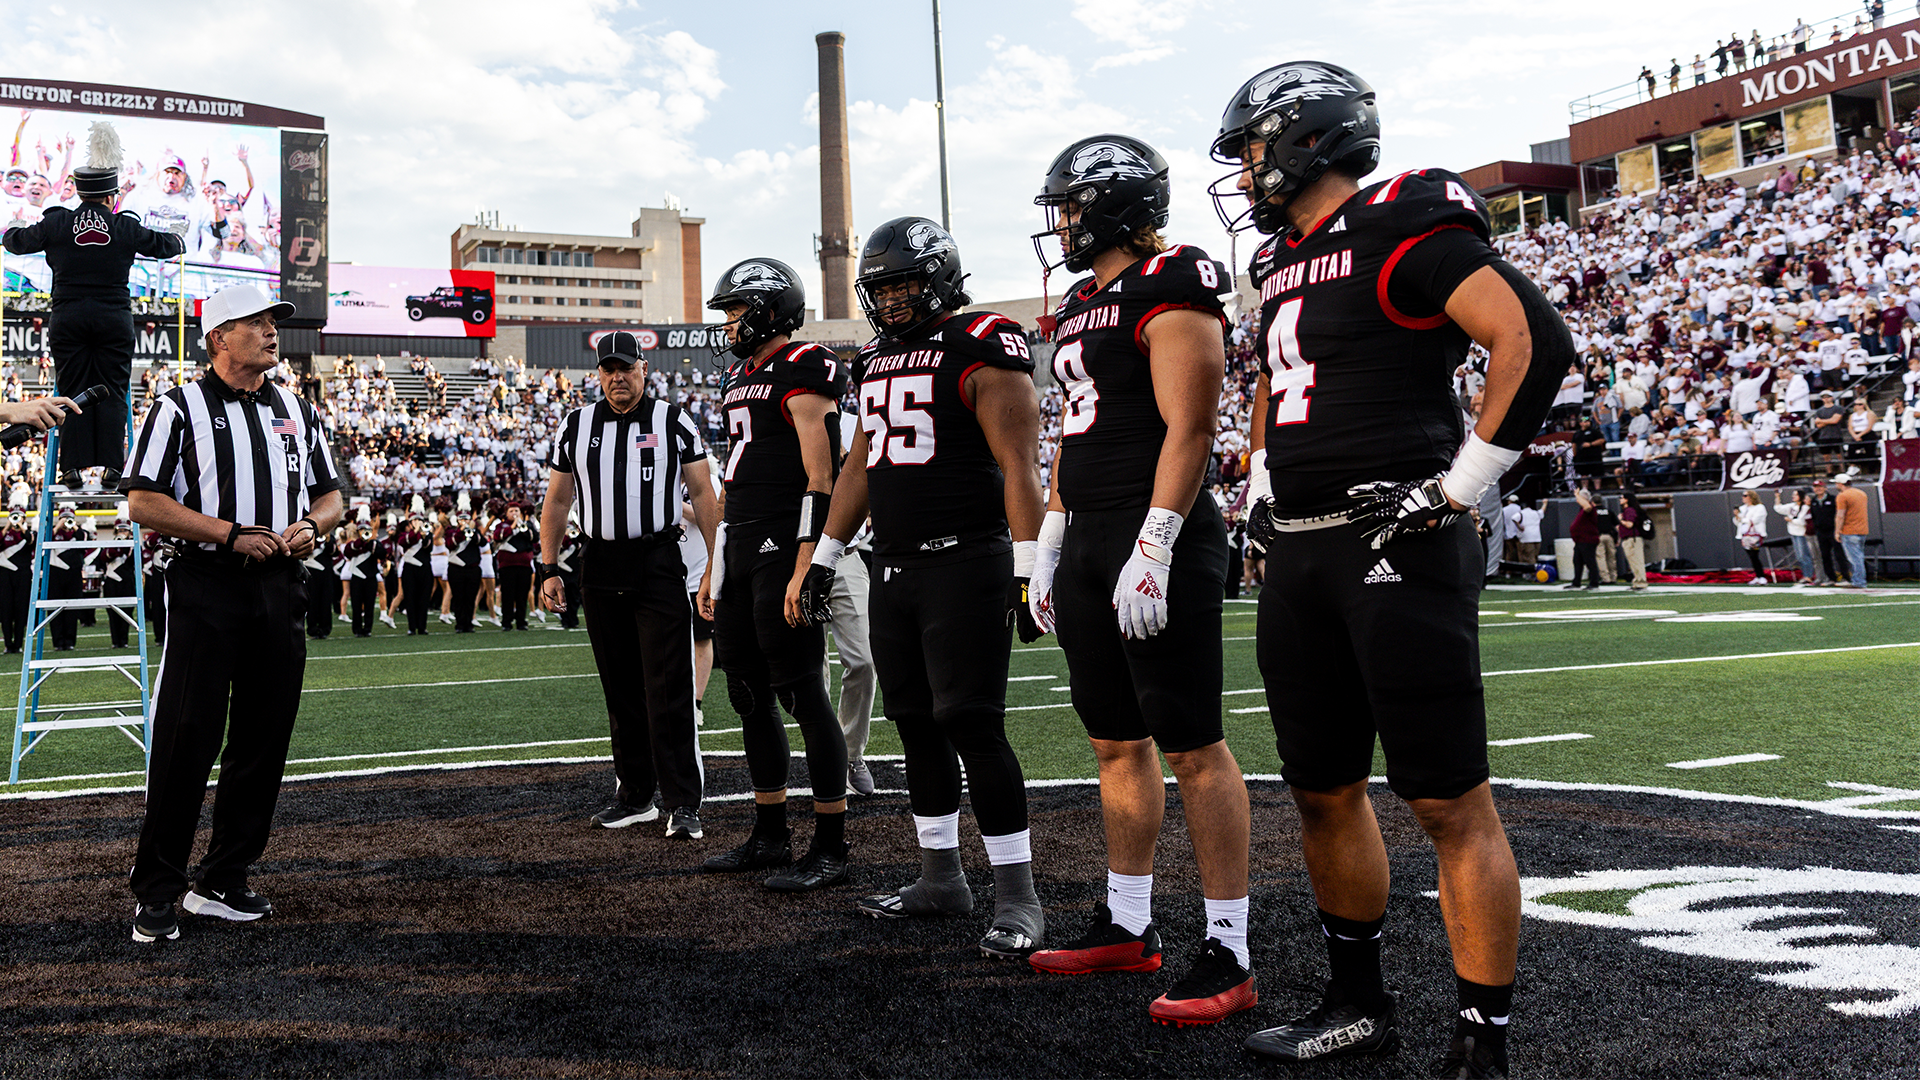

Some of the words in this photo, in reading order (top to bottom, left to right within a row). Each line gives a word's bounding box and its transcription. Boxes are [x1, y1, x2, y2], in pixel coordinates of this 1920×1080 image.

[163, 97, 245, 117] STADIUM
[1445, 181, 1477, 212] 4
[1195, 259, 1218, 289] 8
[1309, 248, 1352, 284] UTAH
[1087, 304, 1120, 331] UTAH
[666, 330, 687, 348] GO
[688, 330, 707, 347] GO
[997, 332, 1030, 360] 55
[824, 358, 837, 382] 7
[907, 349, 945, 369] UTAH
[1266, 295, 1316, 427] 4
[746, 383, 773, 400] UTAH
[1054, 338, 1100, 437] 8
[214, 417, 227, 430] S
[859, 373, 937, 470] 55
[590, 436, 601, 448] S
[724, 405, 752, 482] 7
[287, 453, 299, 472] R
[642, 466, 653, 481] U
[1730, 451, 1785, 488] Griz
[1145, 571, 1163, 600] adidas
[1364, 572, 1402, 584] adidas
